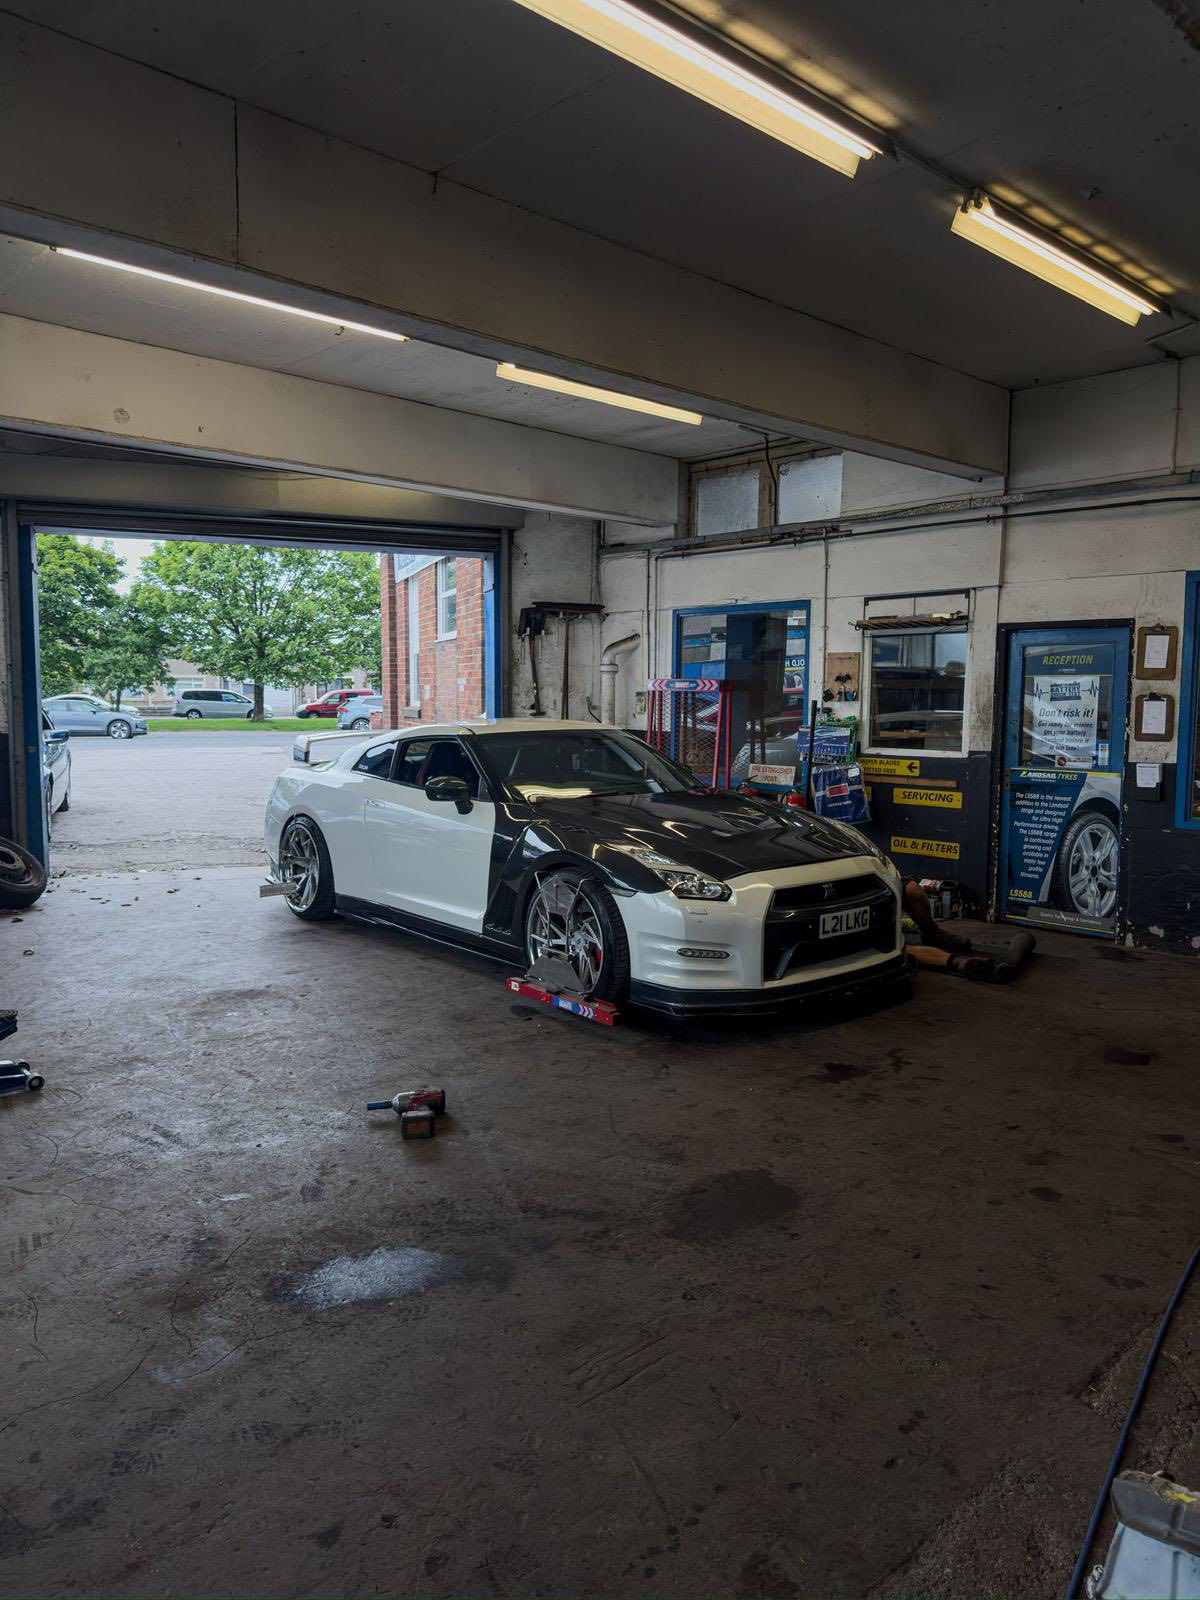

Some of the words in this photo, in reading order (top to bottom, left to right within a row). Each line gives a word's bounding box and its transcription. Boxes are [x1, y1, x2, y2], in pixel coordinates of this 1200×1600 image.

[1042, 655, 1093, 664] RECEPTION
[1039, 708, 1061, 717] Don't
[1064, 708, 1080, 717] risk
[1083, 708, 1094, 717] it!
[762, 766, 792, 774] EXTINGUISHER
[1020, 770, 1057, 778] LANDSAIL
[1058, 773, 1078, 781] TYRES
[902, 791, 954, 802] SERVICING
[893, 839, 908, 849] OIL
[910, 840, 919, 850] &
[921, 842, 958, 854] FILTERS
[1010, 889, 1032, 899] LS588
[822, 915, 842, 935] L21
[846, 910, 868, 930] LKG
